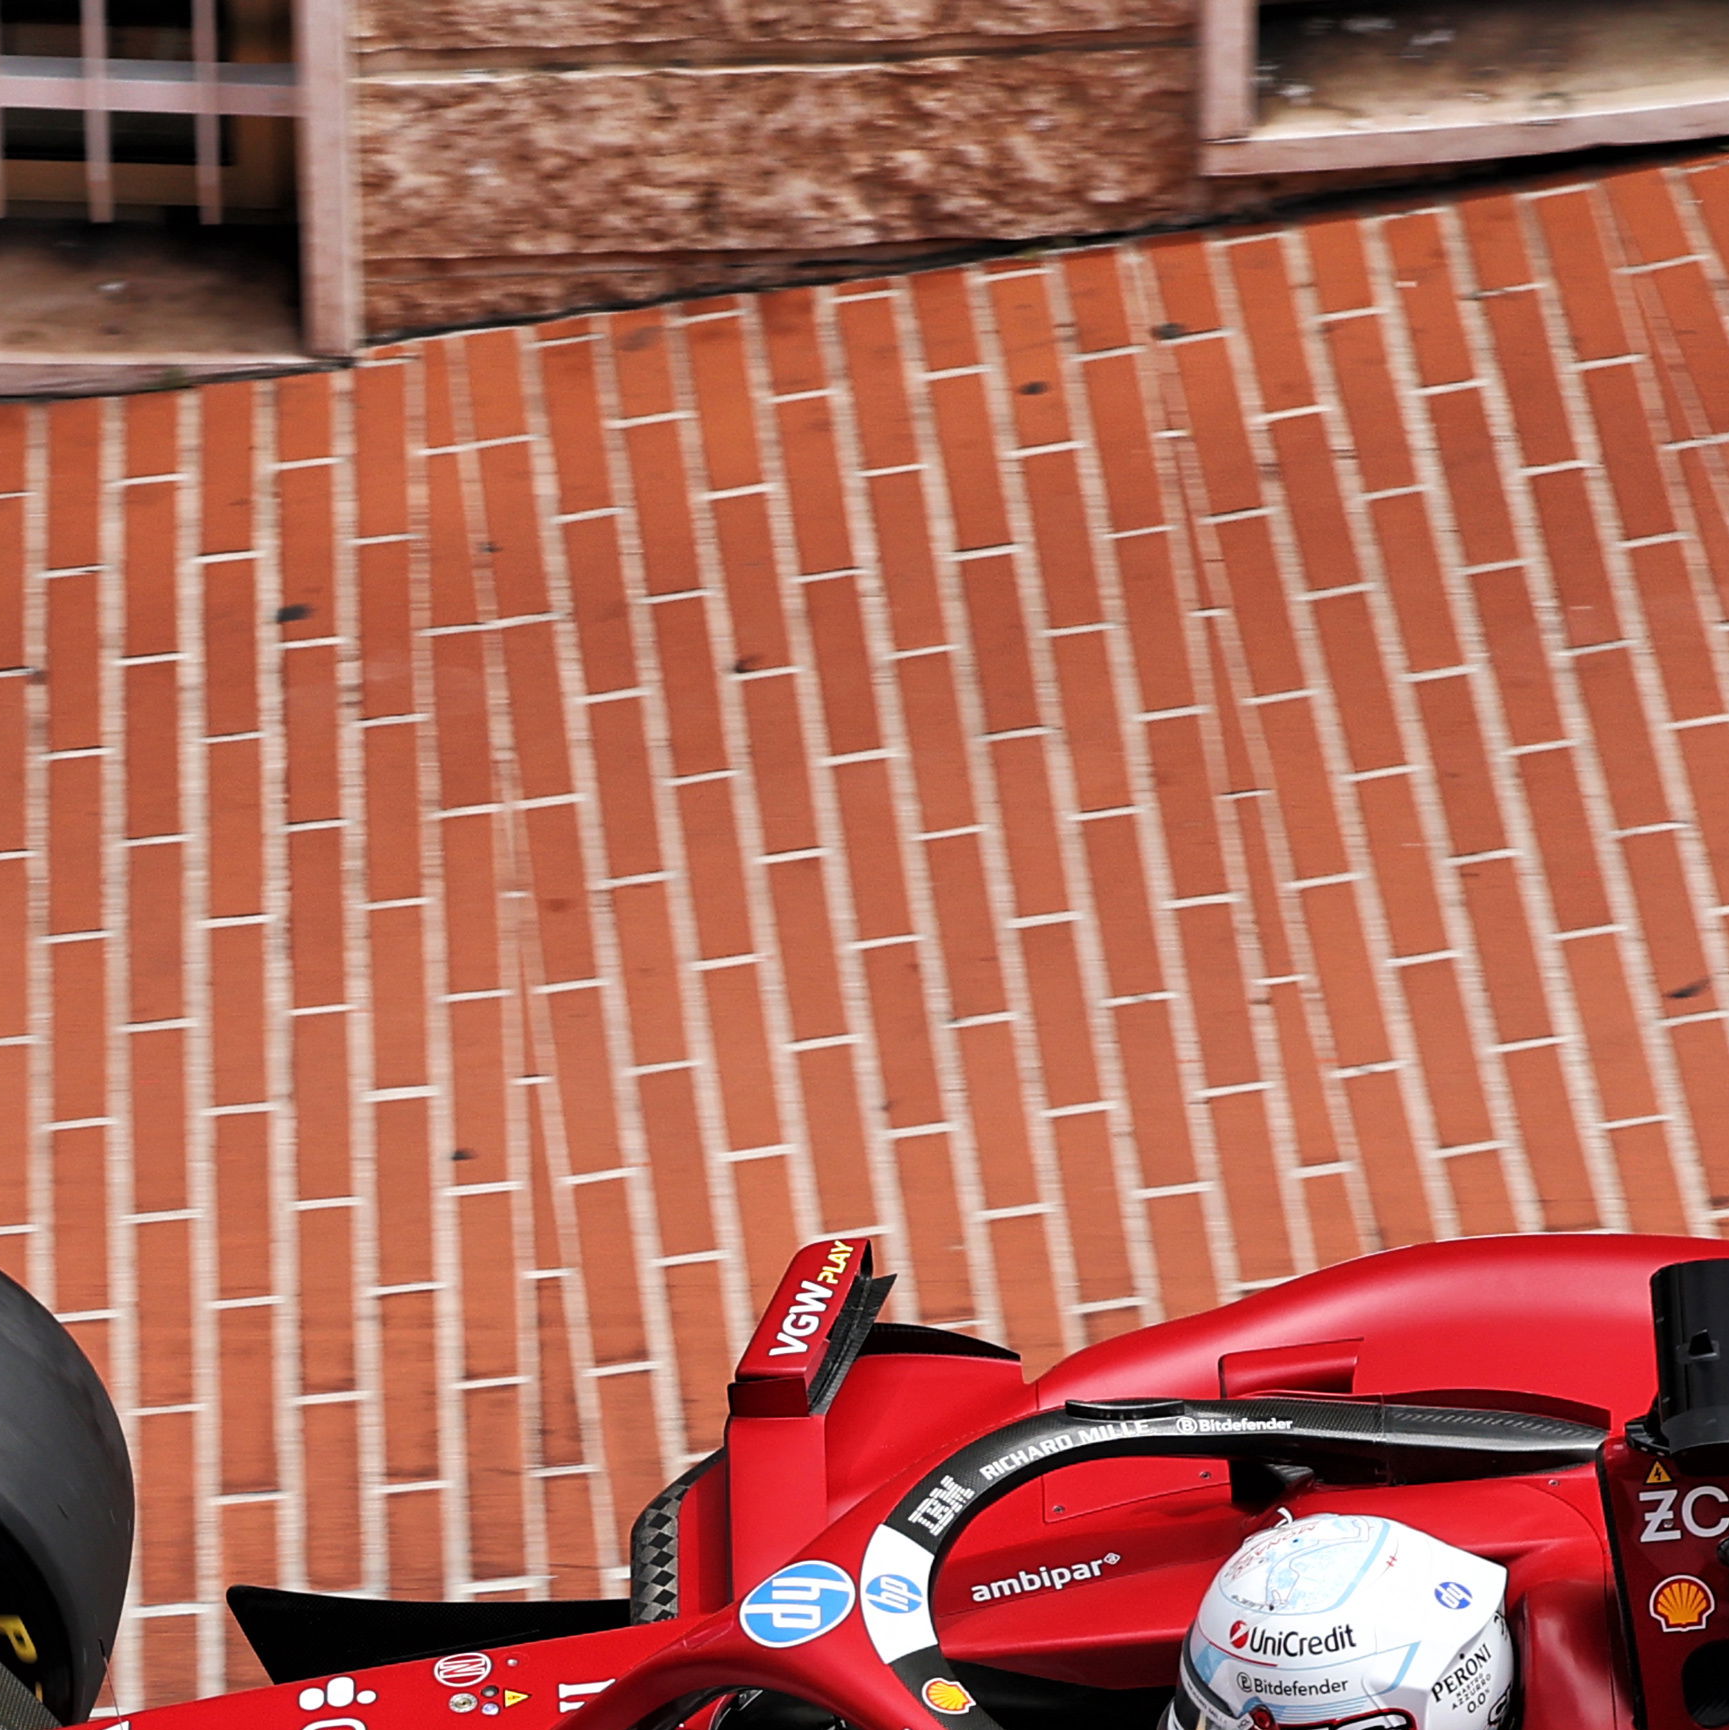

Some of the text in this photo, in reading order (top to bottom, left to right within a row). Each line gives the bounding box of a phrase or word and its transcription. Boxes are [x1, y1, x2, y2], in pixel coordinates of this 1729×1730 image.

[769, 1239, 854, 1356] VGW PLAY
[1198, 1414, 1293, 1434] Bitdefender
[979, 1417, 1151, 1481] RICHARD MILLE
[908, 1475, 976, 1536] IBM
[869, 1574, 923, 1612] hp
[972, 1556, 1103, 1602] ambipar
[1249, 1624, 1356, 1657] UniCredit
[1253, 1678, 1348, 1696] Bitdefender
[1431, 1644, 1492, 1702] PERONI
[1452, 1674, 1491, 1710] AZZURRO
